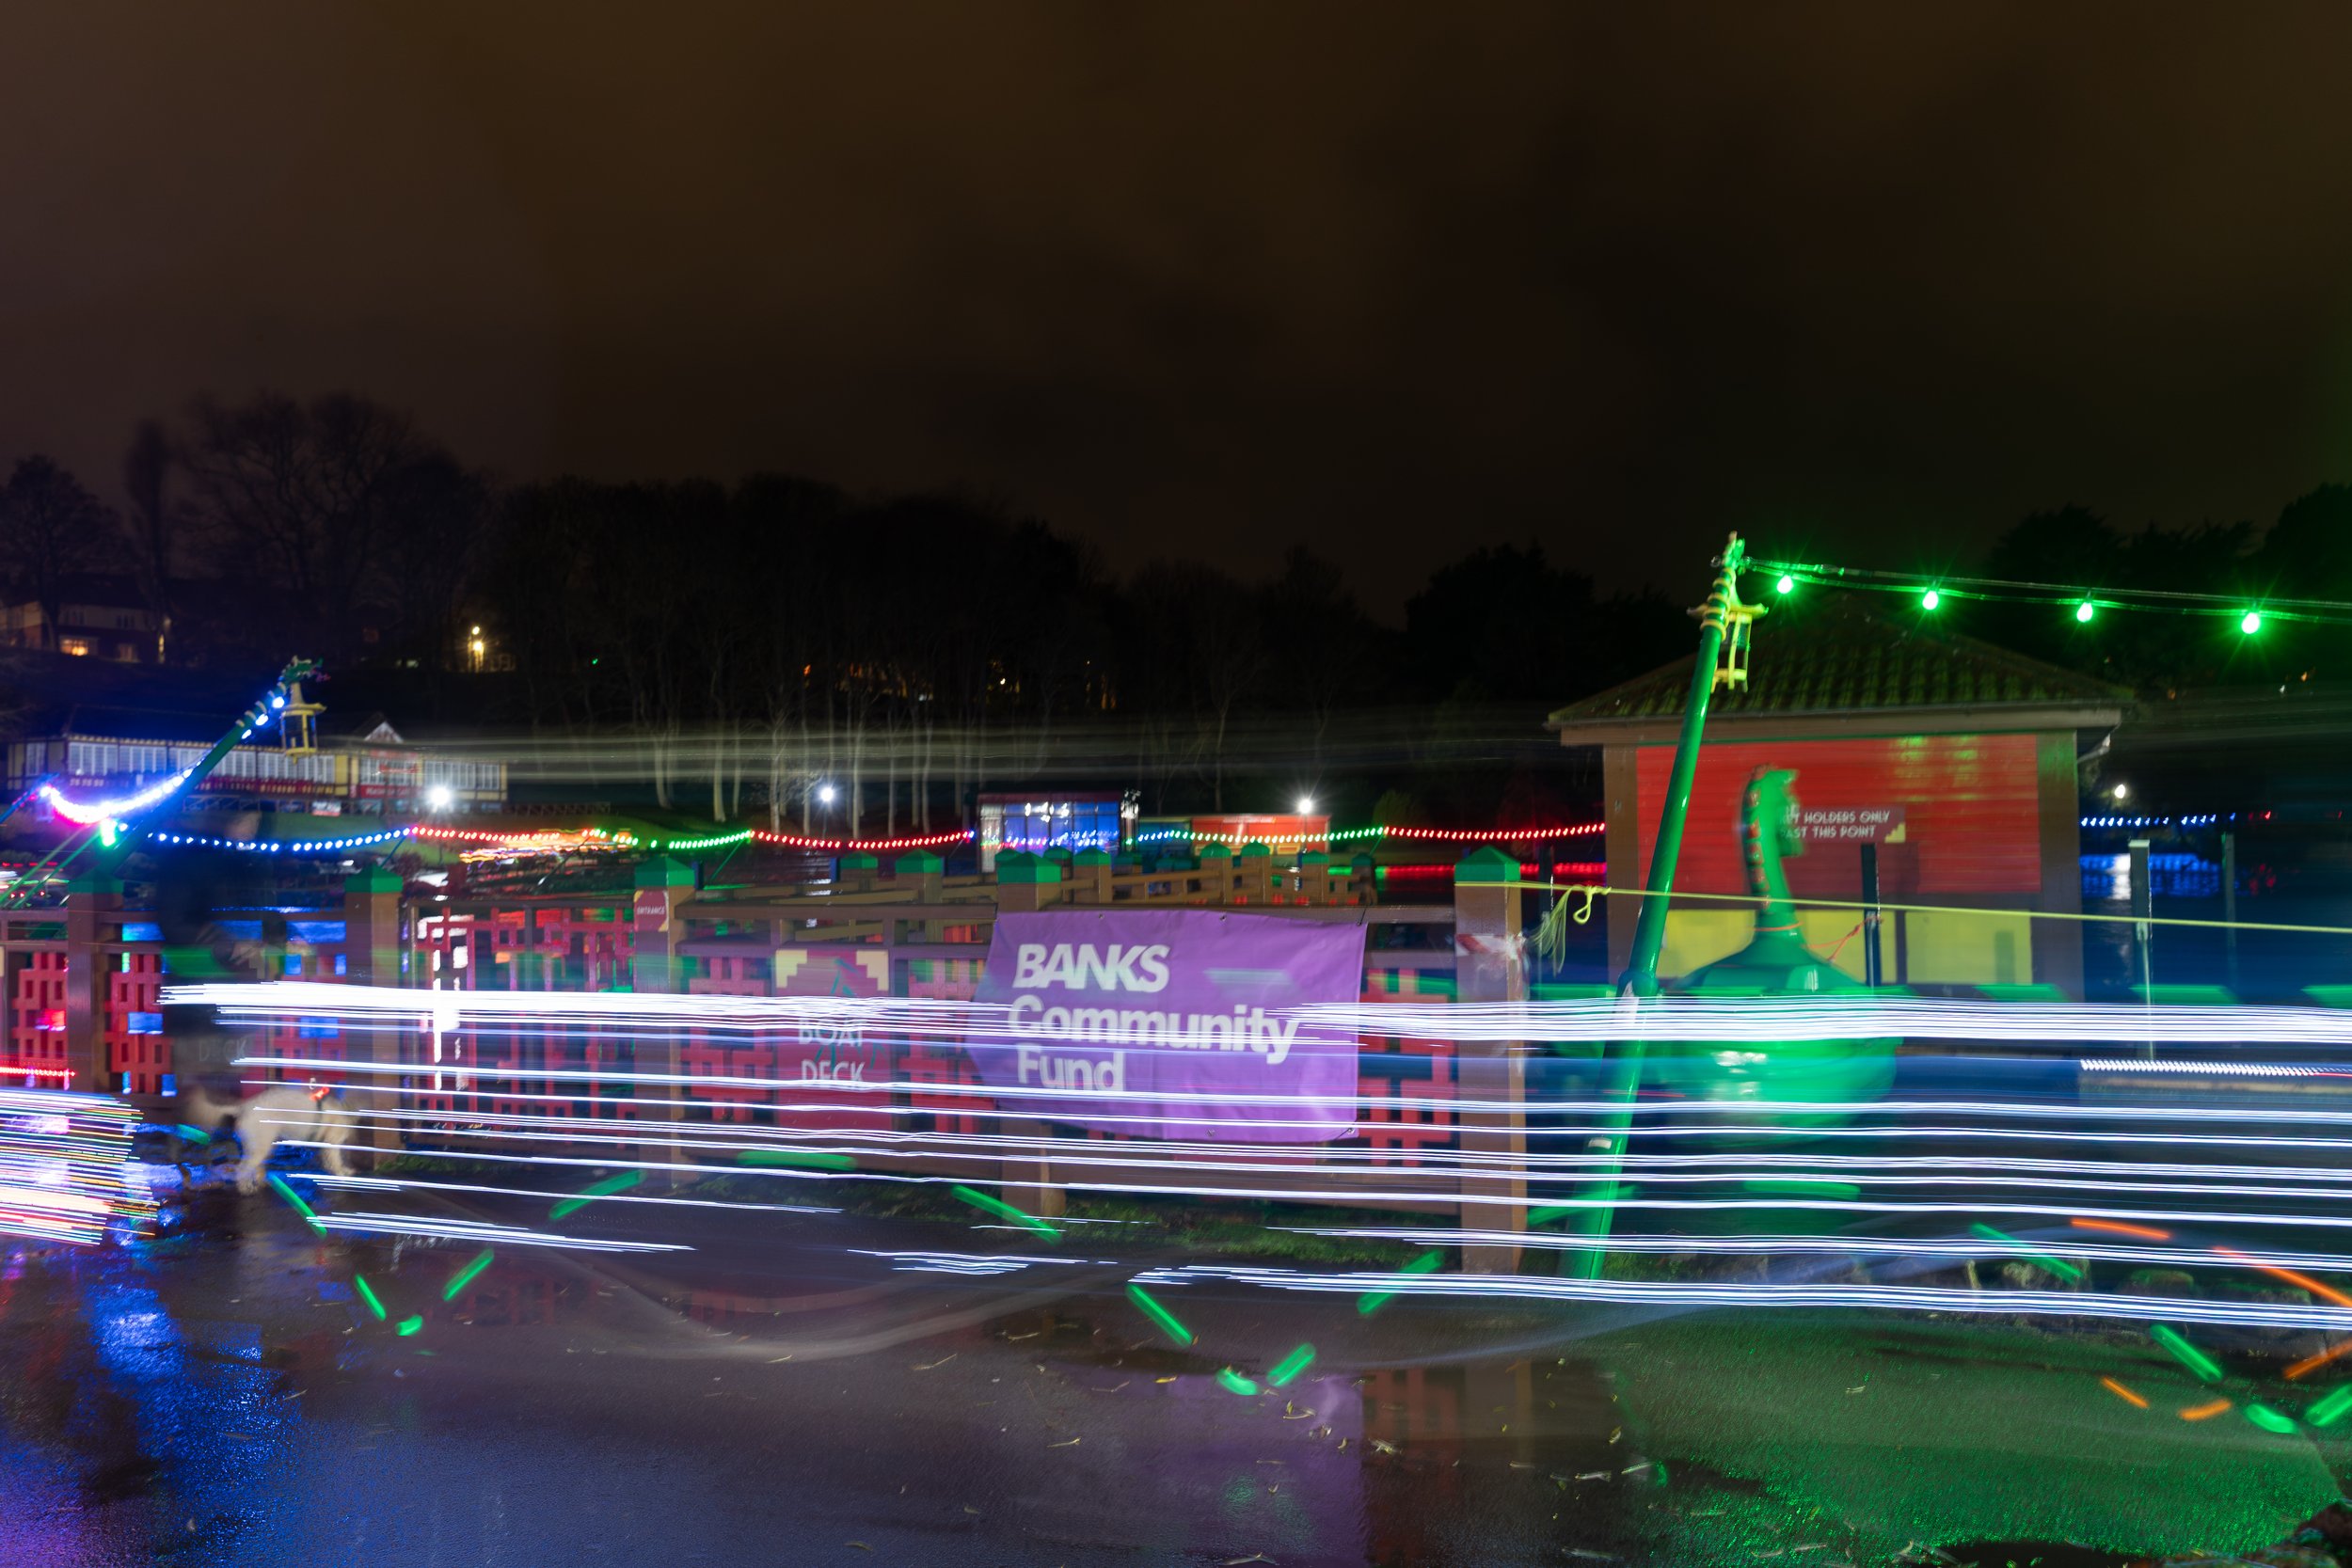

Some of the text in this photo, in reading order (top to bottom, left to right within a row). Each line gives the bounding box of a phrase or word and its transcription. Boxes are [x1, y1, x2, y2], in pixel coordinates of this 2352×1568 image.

[1783, 825, 1877, 839] AST THIS POINT
[1804, 811, 1856, 824] HOLDERS
[1859, 810, 1890, 823] ONLY
[1012, 943, 1170, 993] BANKS
[1008, 994, 1301, 1065] Community
[801, 1059, 866, 1083] DECK
[1015, 1042, 1125, 1091] Fund
